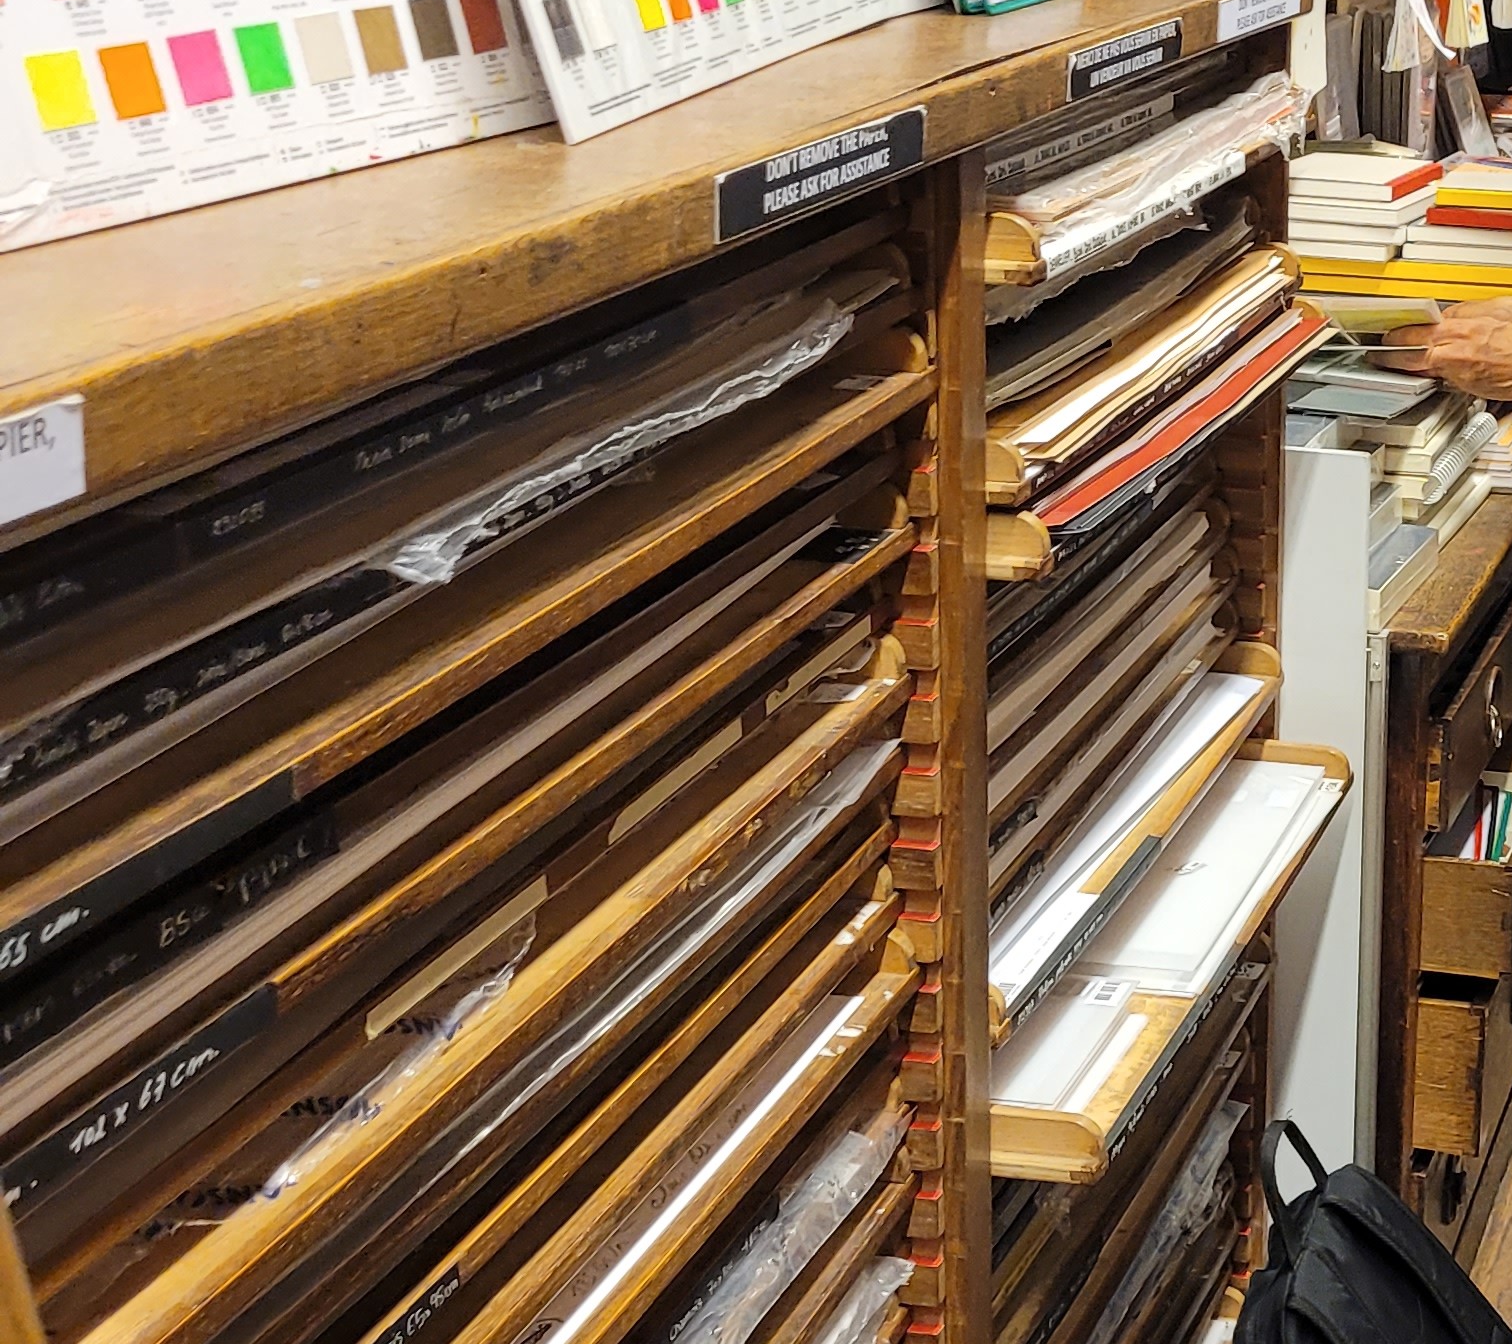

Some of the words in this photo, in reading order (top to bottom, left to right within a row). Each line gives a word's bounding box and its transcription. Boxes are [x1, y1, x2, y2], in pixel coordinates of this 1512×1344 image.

[763, 181, 800, 214] PLEASE
[800, 174, 820, 200] ASK
[820, 168, 840, 191] FOR
[840, 148, 890, 184] ASSISTANCE
[765, 152, 798, 182] DON'T
[799, 137, 840, 170] REMOVE
[840, 131, 858, 154] THE
